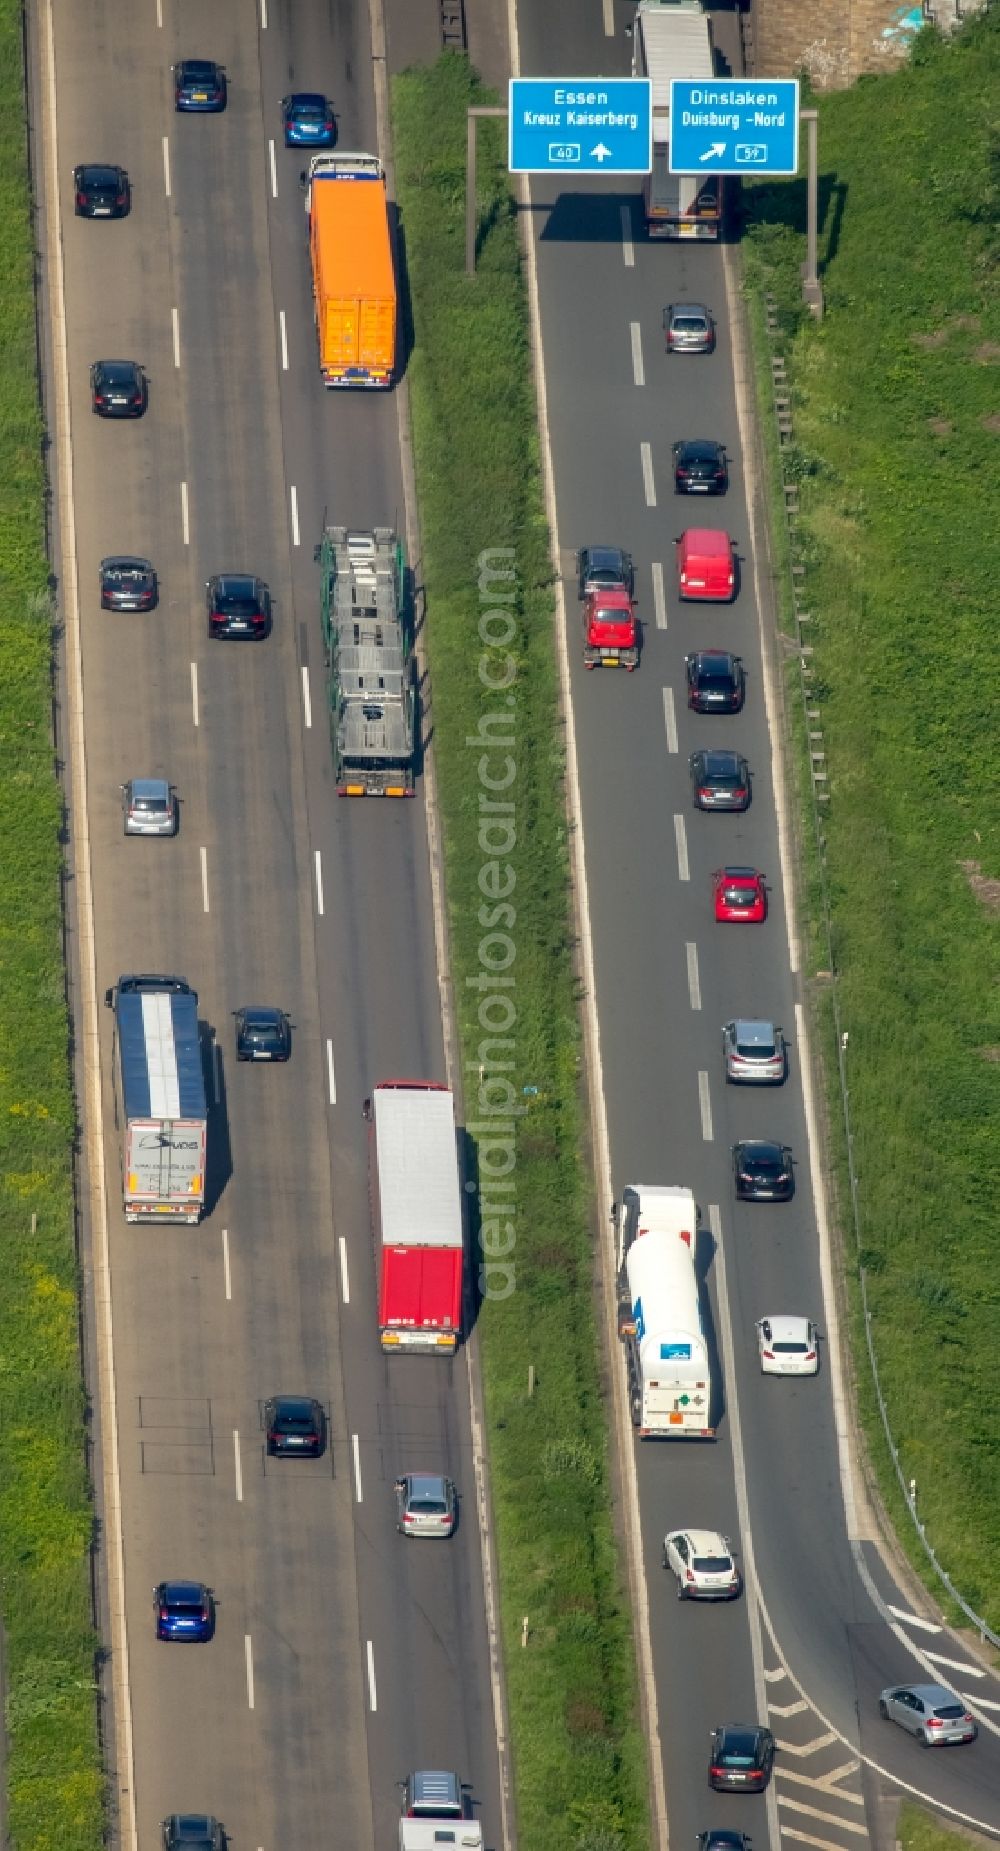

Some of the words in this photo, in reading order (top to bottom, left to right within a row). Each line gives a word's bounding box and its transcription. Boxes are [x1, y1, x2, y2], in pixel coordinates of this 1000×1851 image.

[554, 89, 608, 105] Essen
[689, 89, 778, 105] Dinslaken
[523, 111, 561, 126] Kreuz
[566, 111, 639, 130] Kaiserberg
[682, 111, 740, 131] Duisburg
[556, 147, 573, 159] 40
[744, 147, 760, 160] 59
